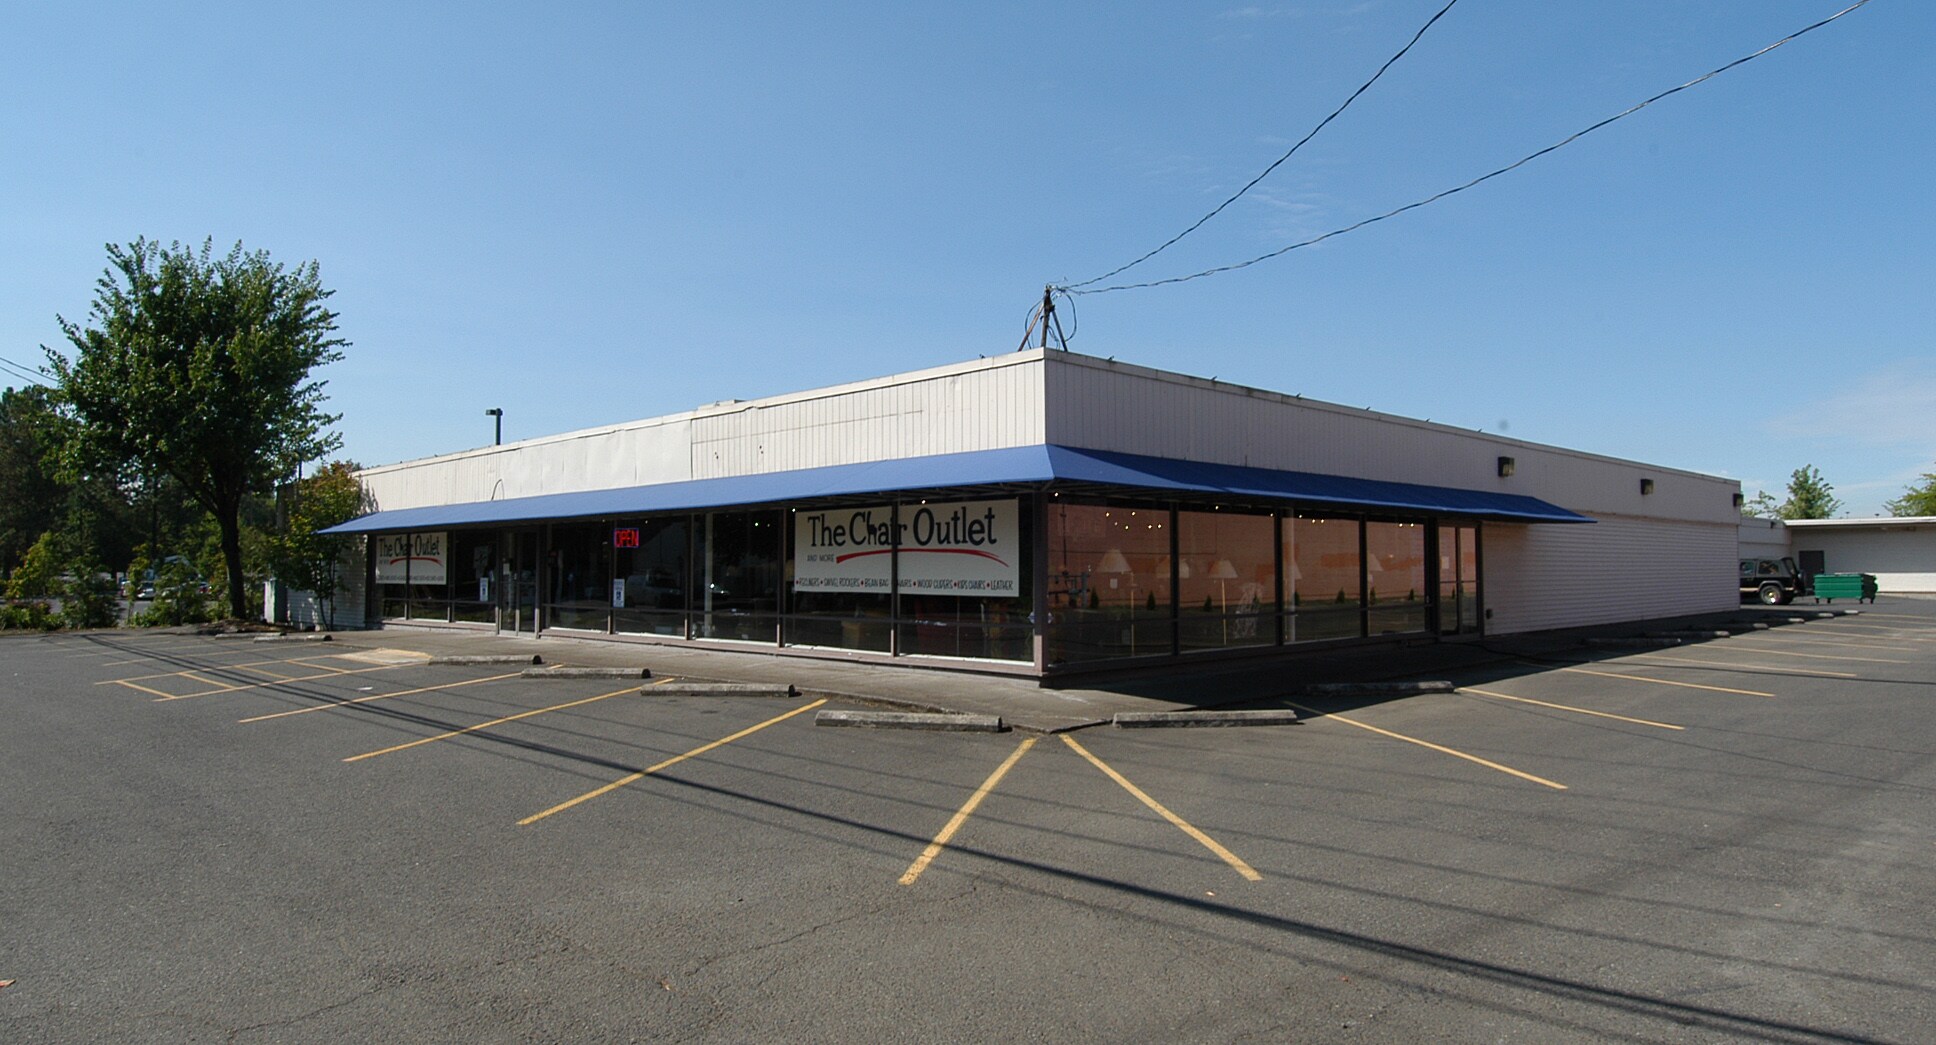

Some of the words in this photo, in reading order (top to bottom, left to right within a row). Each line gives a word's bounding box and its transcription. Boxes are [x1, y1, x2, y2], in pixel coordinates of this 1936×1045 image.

[807, 513, 846, 547] The
[913, 506, 997, 546] Outlet
[379, 537, 393, 557] The
[415, 534, 440, 556] Outlet
[614, 528, 639, 548] OPEN
[819, 553, 835, 562] MORE
[917, 579, 932, 588] WOOD
[990, 580, 1013, 590] LEATHER
